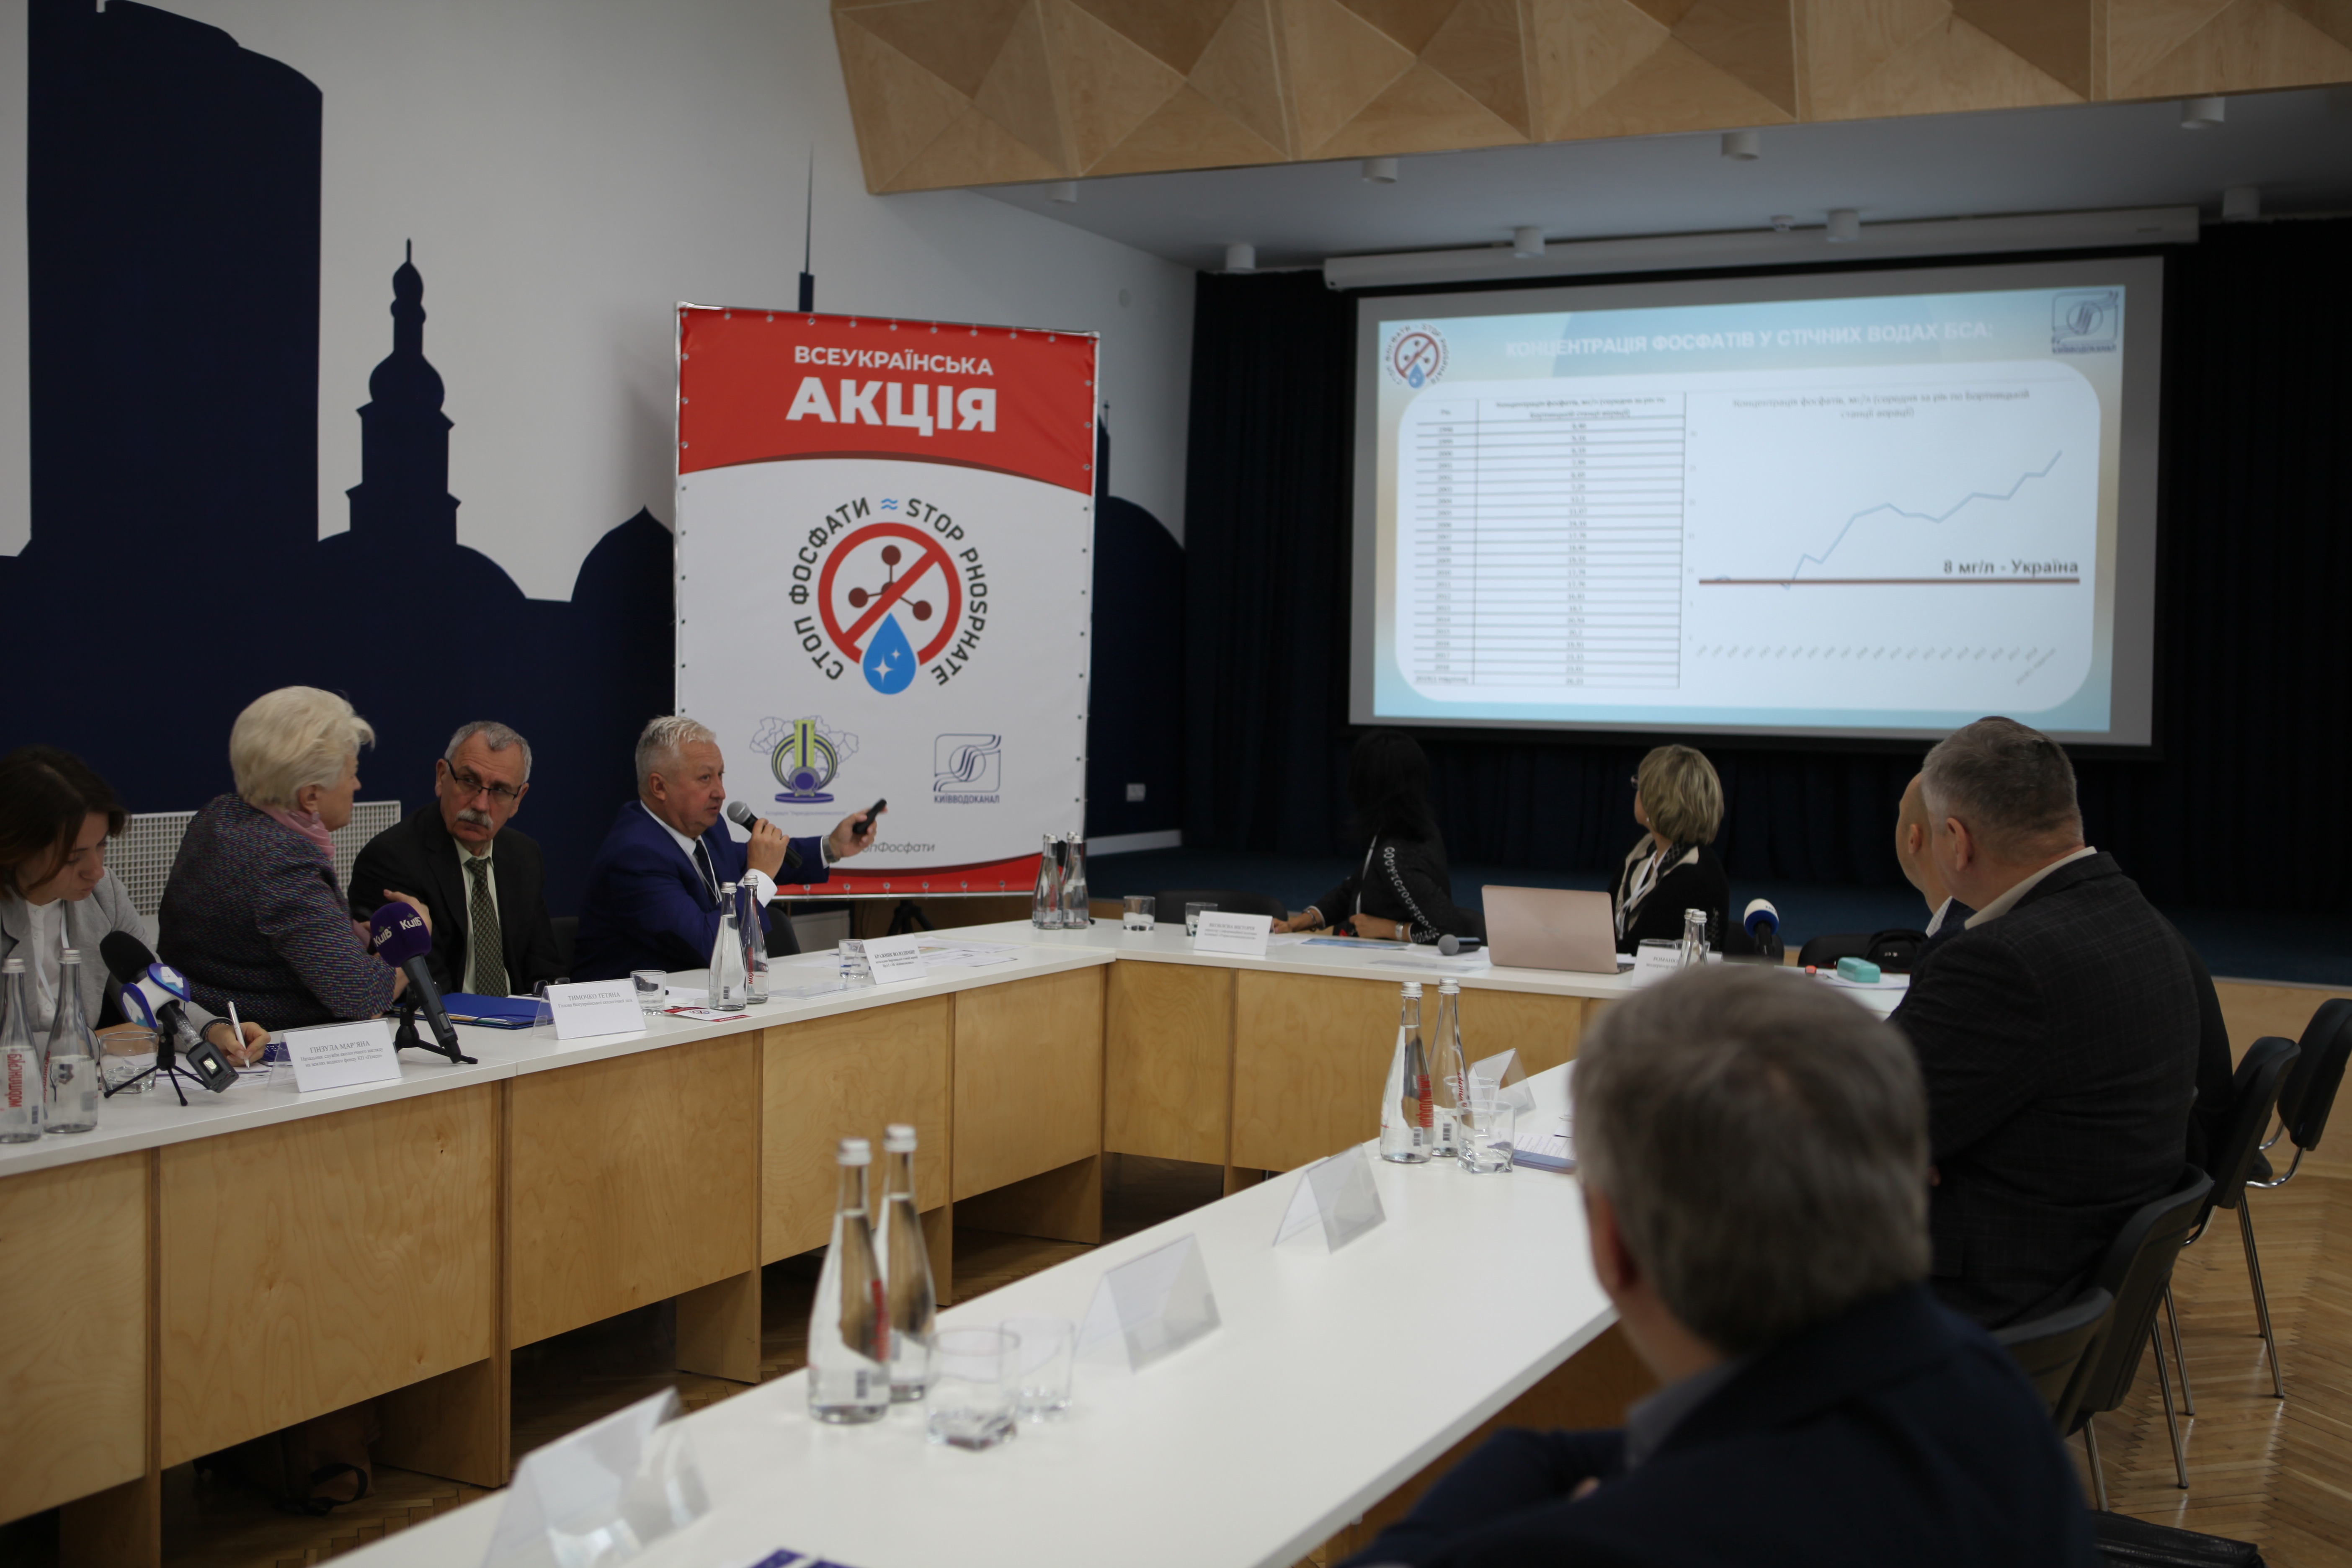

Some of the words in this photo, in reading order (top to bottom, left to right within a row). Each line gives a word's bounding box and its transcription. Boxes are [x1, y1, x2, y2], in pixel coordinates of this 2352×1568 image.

[1506, 336, 1647, 357] КОНЦЕНТРАЦІЯ
[1652, 331, 1755, 351] ФОСФАТІВ
[1760, 330, 1772, 347] У
[1777, 327, 1862, 346] СТІЧНИХ
[1867, 324, 1938, 344] ВОДАХ
[794, 346, 993, 376] ВСЕУКРАЇНСЬКА
[785, 377, 996, 436] АКЦІЯ
[906, 498, 964, 541] STOP
[789, 497, 871, 605] ФОСФАТИ
[1944, 560, 1952, 574] 8
[2012, 558, 2078, 578] Україна
[931, 547, 987, 686] PHOSPHATE
[794, 616, 843, 680] СТОП
[934, 793, 1000, 804] КИЇВВОДОКАНАЛ
[862, 841, 935, 854] опФосфати
